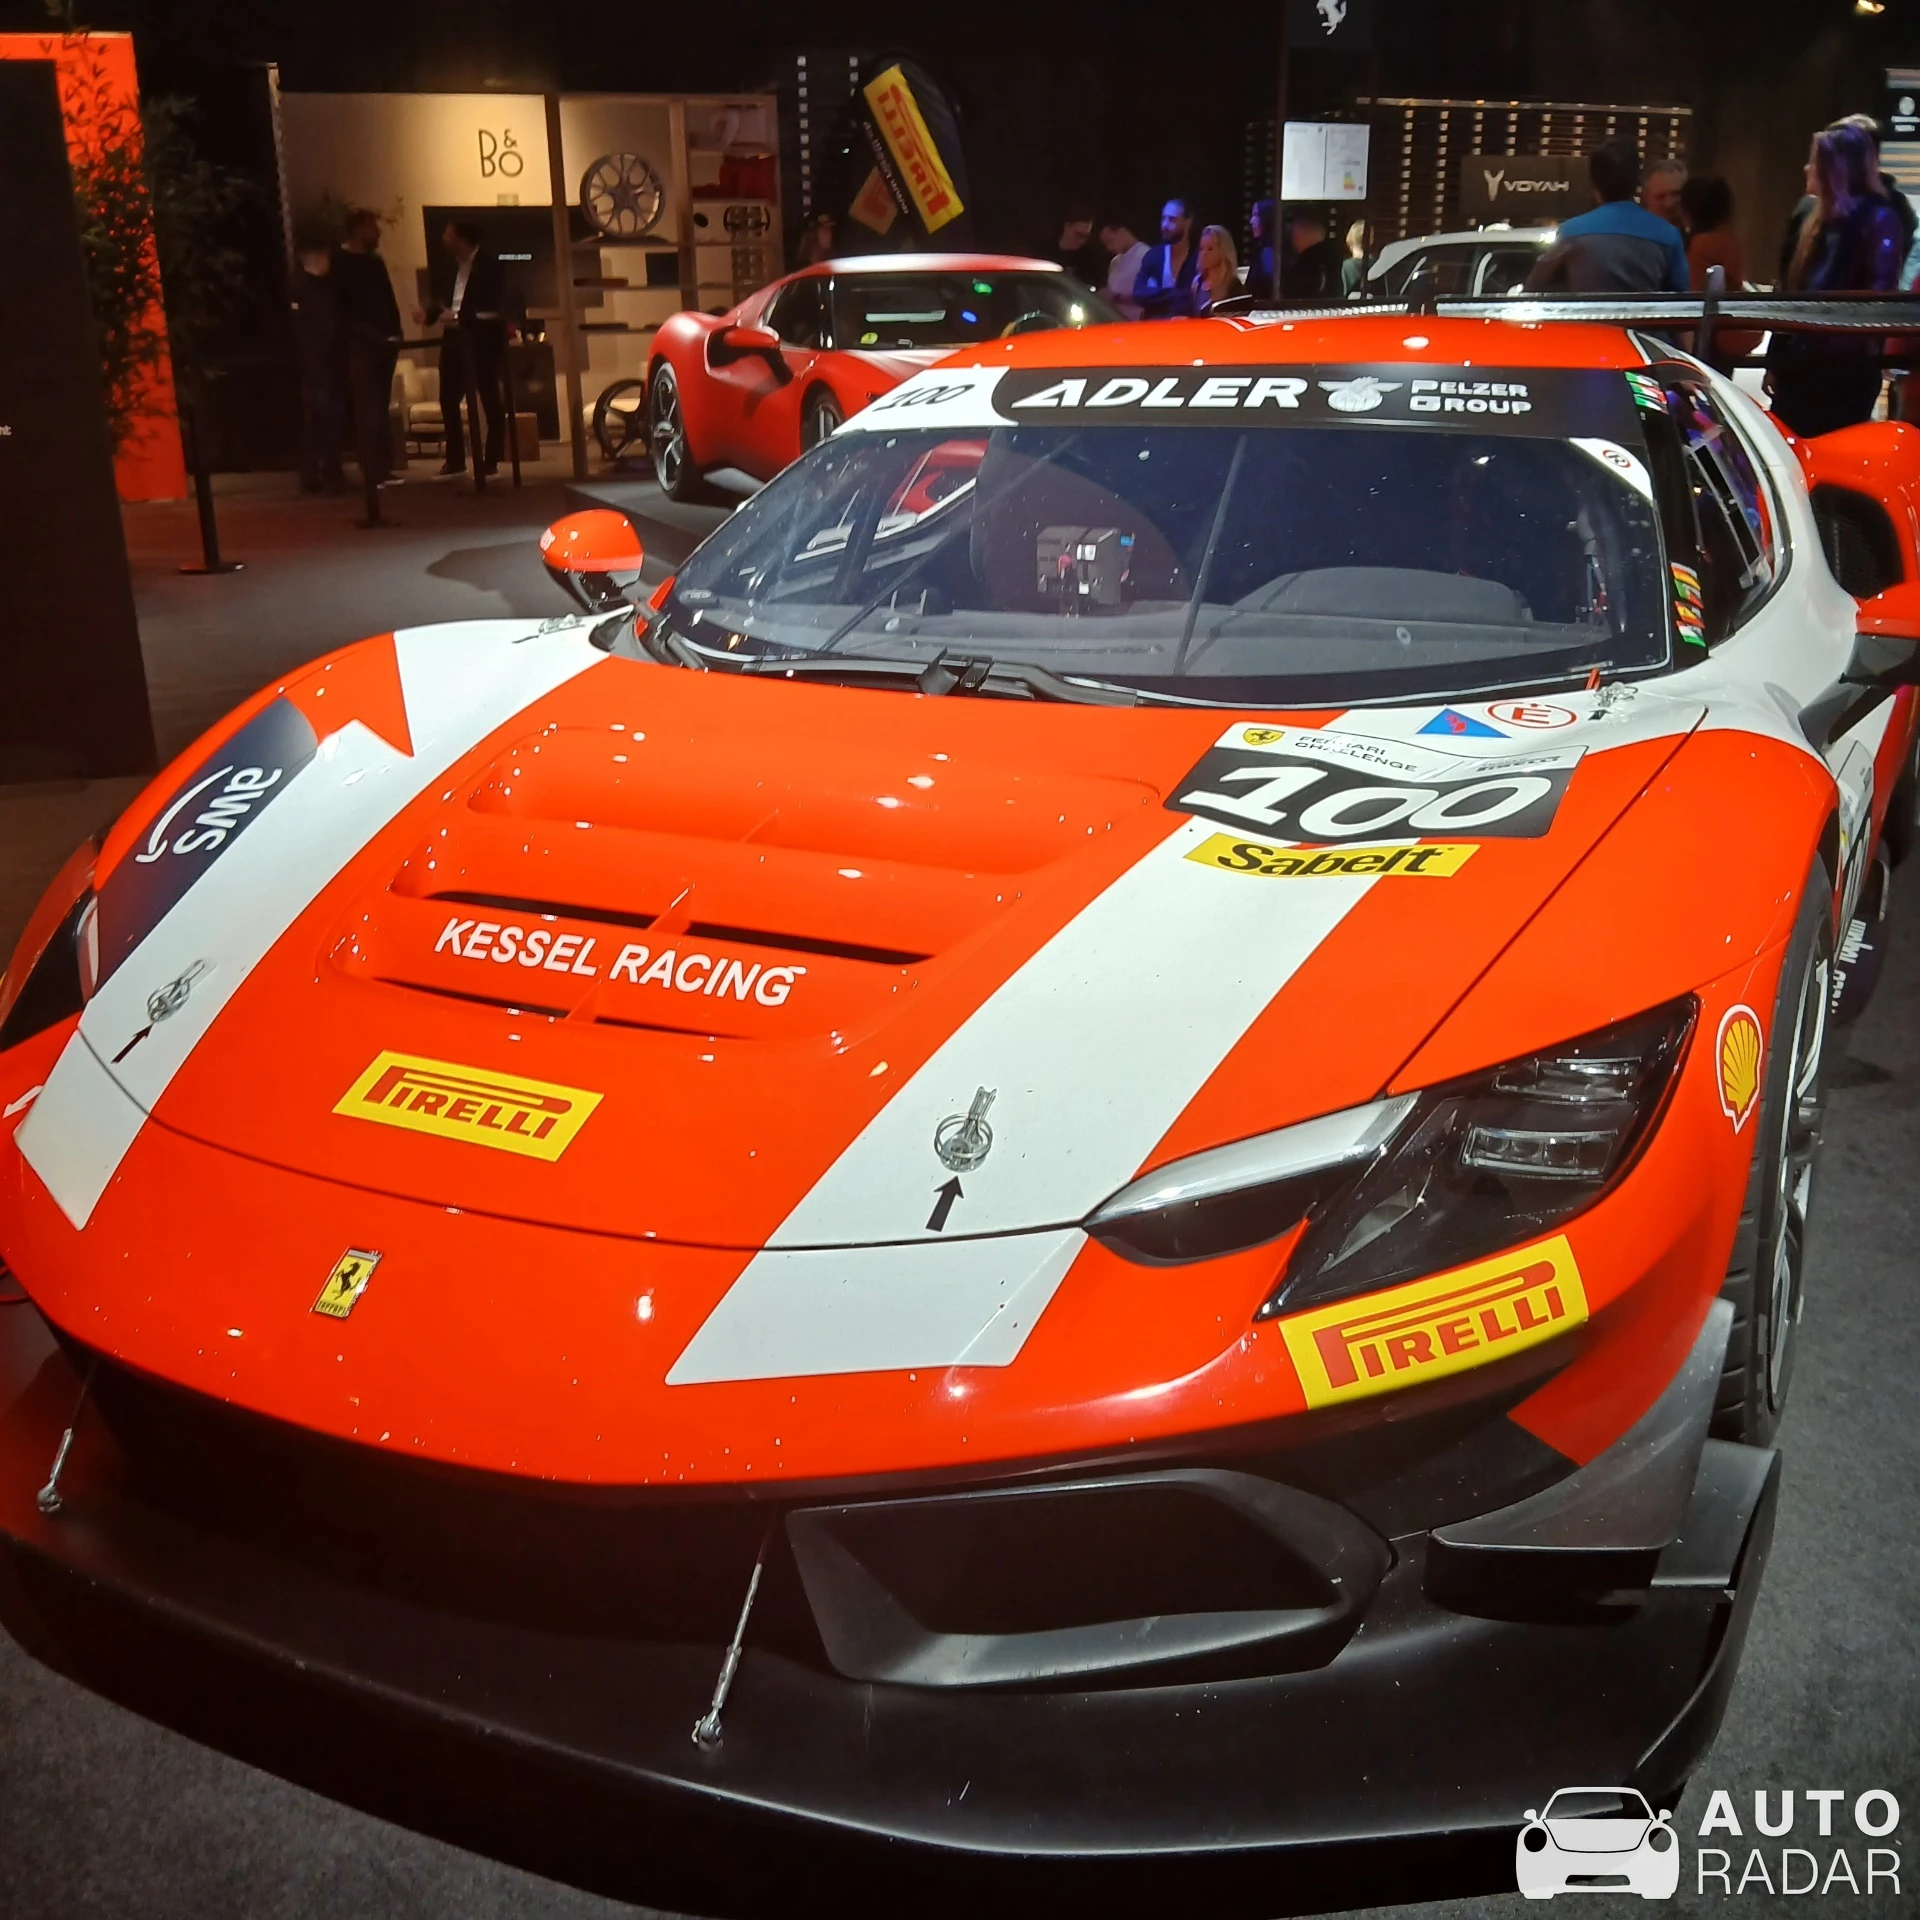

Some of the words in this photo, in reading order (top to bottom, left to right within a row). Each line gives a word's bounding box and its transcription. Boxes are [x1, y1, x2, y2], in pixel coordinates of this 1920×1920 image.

[1504, 180, 1570, 192] VOYAH
[872, 383, 976, 412] 100
[1011, 377, 1308, 408] ADLER
[1411, 379, 1528, 397] PELZER
[1409, 395, 1533, 415] GROUP
[1179, 766, 1552, 838] 100
[1216, 843, 1440, 876] Sabelt
[434, 917, 599, 977] KESSEL
[609, 943, 796, 1006] RACING
[362, 1065, 573, 1140] PIRELLI
[1312, 1260, 1565, 1389] PIRELLI
